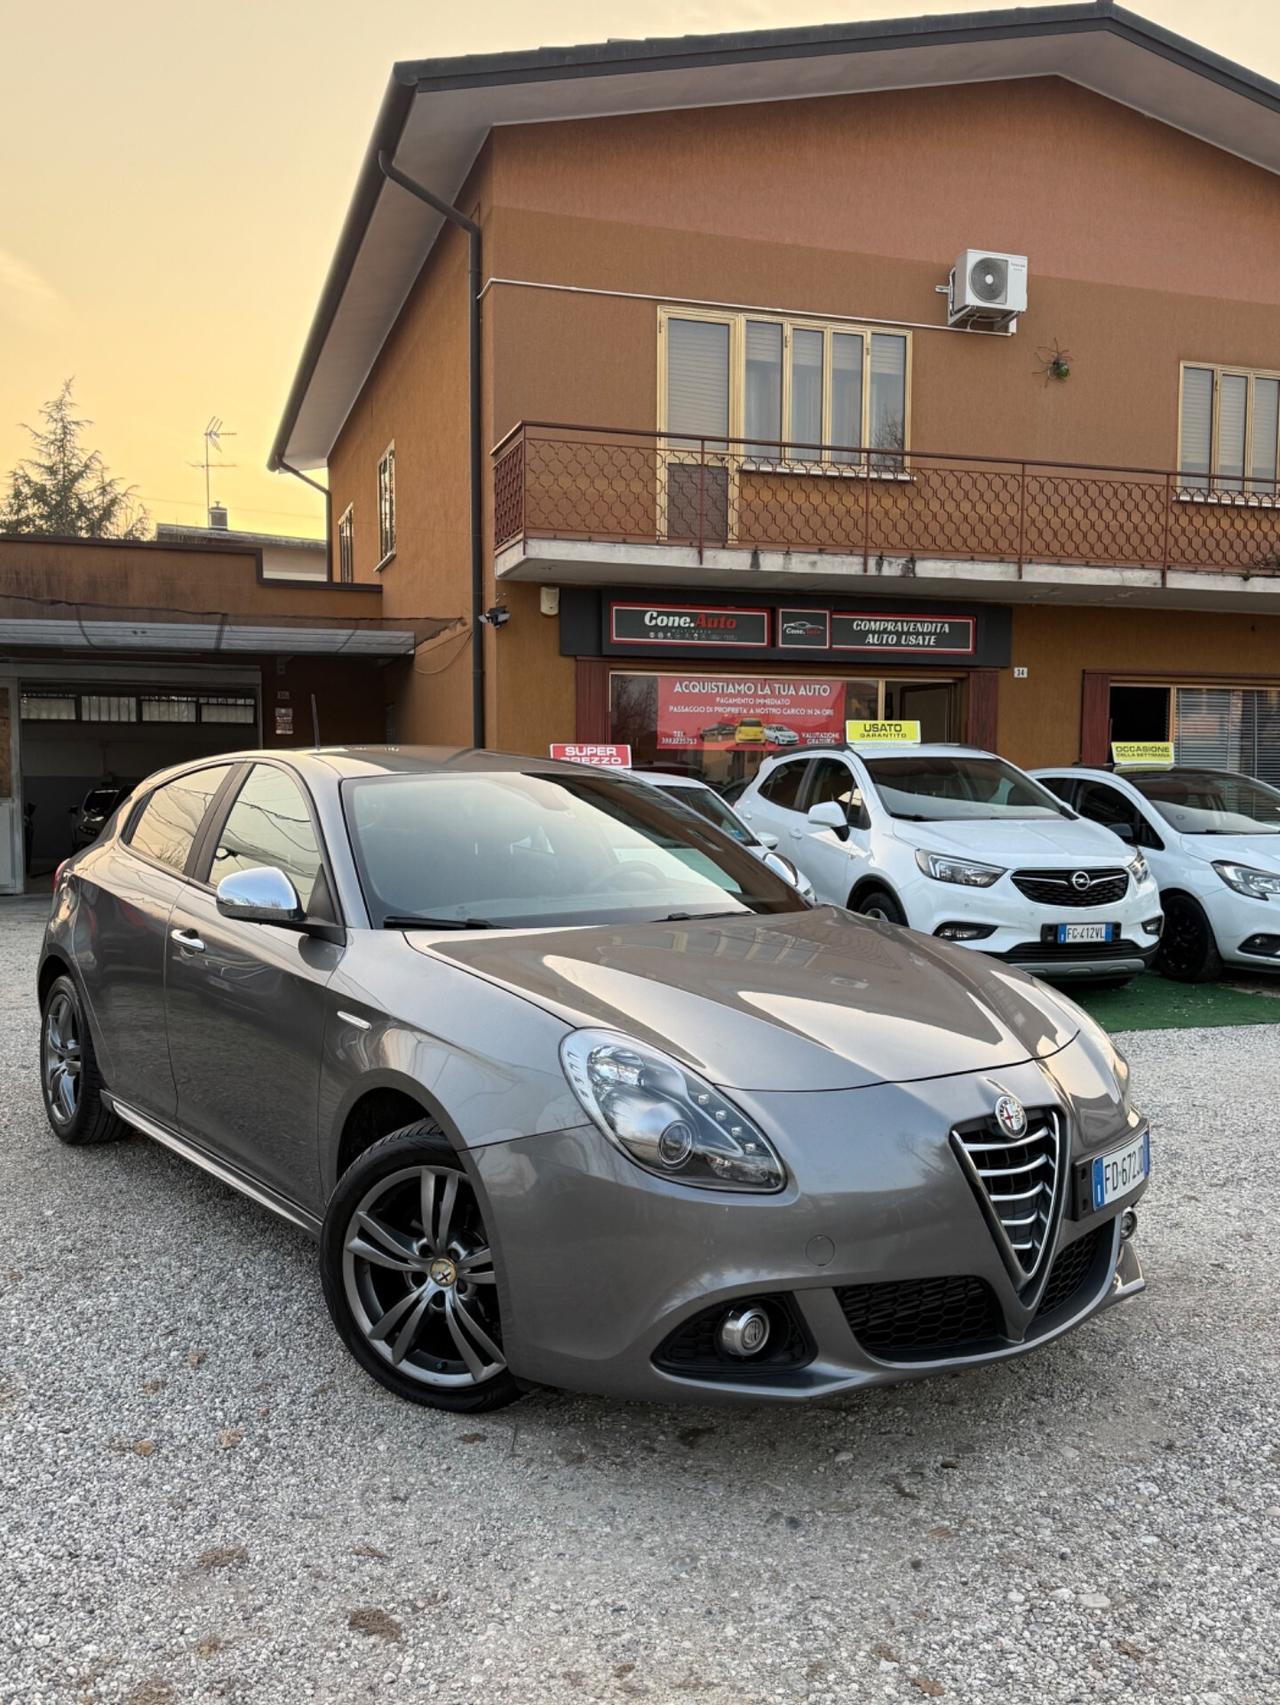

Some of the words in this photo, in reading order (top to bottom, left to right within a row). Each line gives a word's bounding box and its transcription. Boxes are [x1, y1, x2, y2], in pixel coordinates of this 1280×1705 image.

[644, 611, 737, 629] Cone.Auto
[853, 620, 950, 633] COMPRAVENDITA
[865, 633, 897, 645] AUTO
[901, 634, 937, 646] USATE
[673, 681, 755, 694] ACQUISTIAMO
[757, 682, 771, 695] LA
[773, 683, 796, 695] TUA
[798, 684, 831, 696] AUTO
[716, 696, 754, 705] PAGAMENTO
[756, 697, 790, 706] IMMEDIATO
[669, 705, 705, 713] PASSAGGIO
[863, 723, 902, 732] USATO
[565, 746, 617, 756] SUPER
